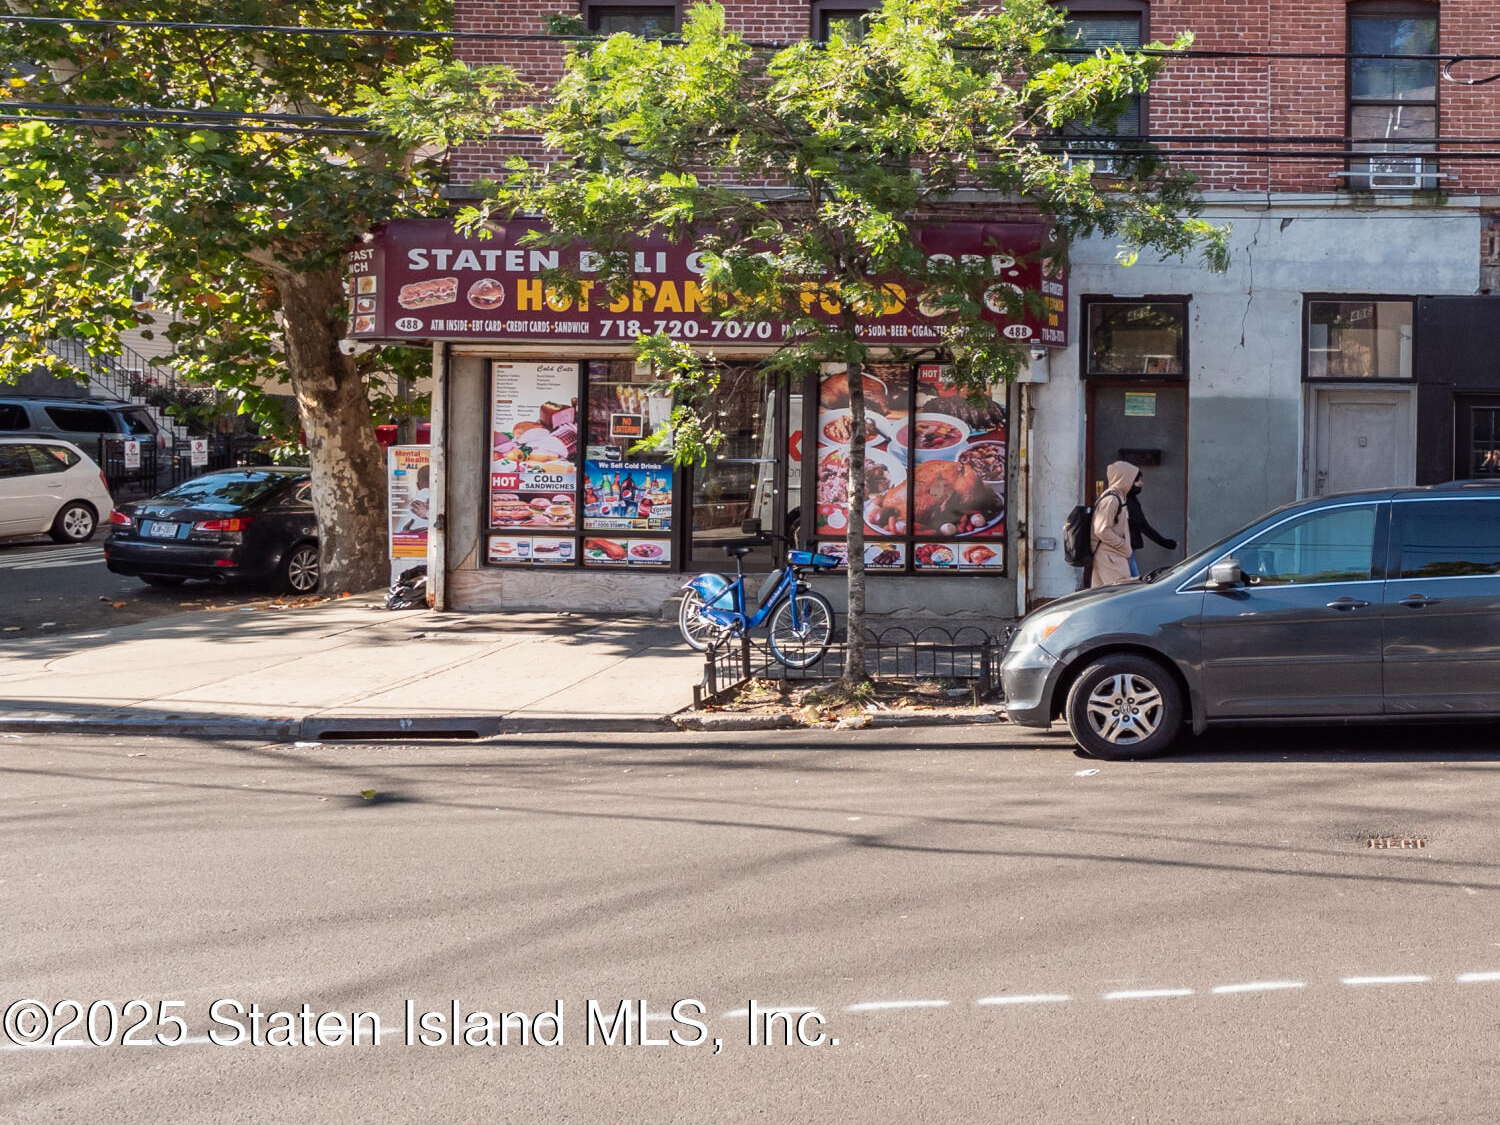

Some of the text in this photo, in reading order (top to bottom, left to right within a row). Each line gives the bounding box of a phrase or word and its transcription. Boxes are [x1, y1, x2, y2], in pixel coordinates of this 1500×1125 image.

[348, 249, 374, 262] FAST
[407, 248, 559, 272] STATEN
[516, 278, 594, 312] HOT
[400, 319, 419, 331] 488
[430, 320, 444, 330] ATM
[446, 321, 468, 331] INSIDE
[471, 322, 483, 331] EBT
[485, 322, 501, 332] CARD
[506, 322, 528, 332] CREDIT
[530, 322, 549, 332] CARDS
[554, 322, 589, 333] SANDWICH
[600, 320, 772, 339] 718-720-7070
[868, 325, 886, 336] SODA
[890, 325, 908, 336] BEER
[1008, 326, 1027, 338] 488
[922, 370, 938, 378] HOT
[624, 462, 640, 470] Cold
[492, 477, 517, 487] HOT
[534, 475, 563, 483] COLD
